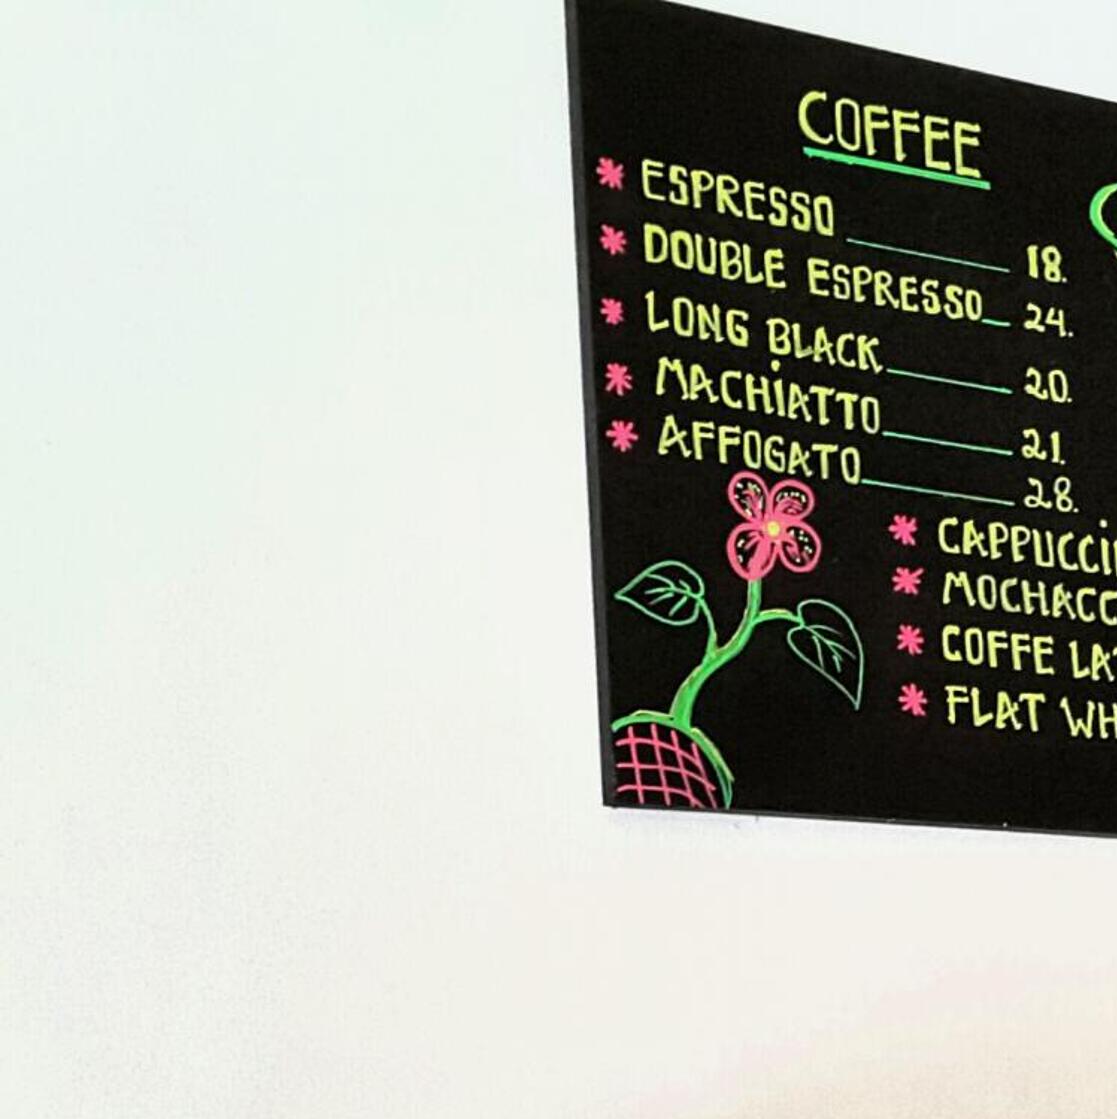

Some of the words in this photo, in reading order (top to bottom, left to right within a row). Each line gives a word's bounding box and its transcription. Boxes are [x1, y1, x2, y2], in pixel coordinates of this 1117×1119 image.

[799, 91, 981, 178] COFFEE
[642, 159, 834, 236] ESPRESSO
[643, 223, 787, 288] DOUBLE
[808, 258, 983, 321] ESPRESSO
[645, 291, 748, 347] LONG
[766, 318, 883, 373] BLACK
[658, 414, 862, 484] AFFOGATO
[942, 625, 1054, 674] COFFE
[945, 685, 1045, 732] FLAT
